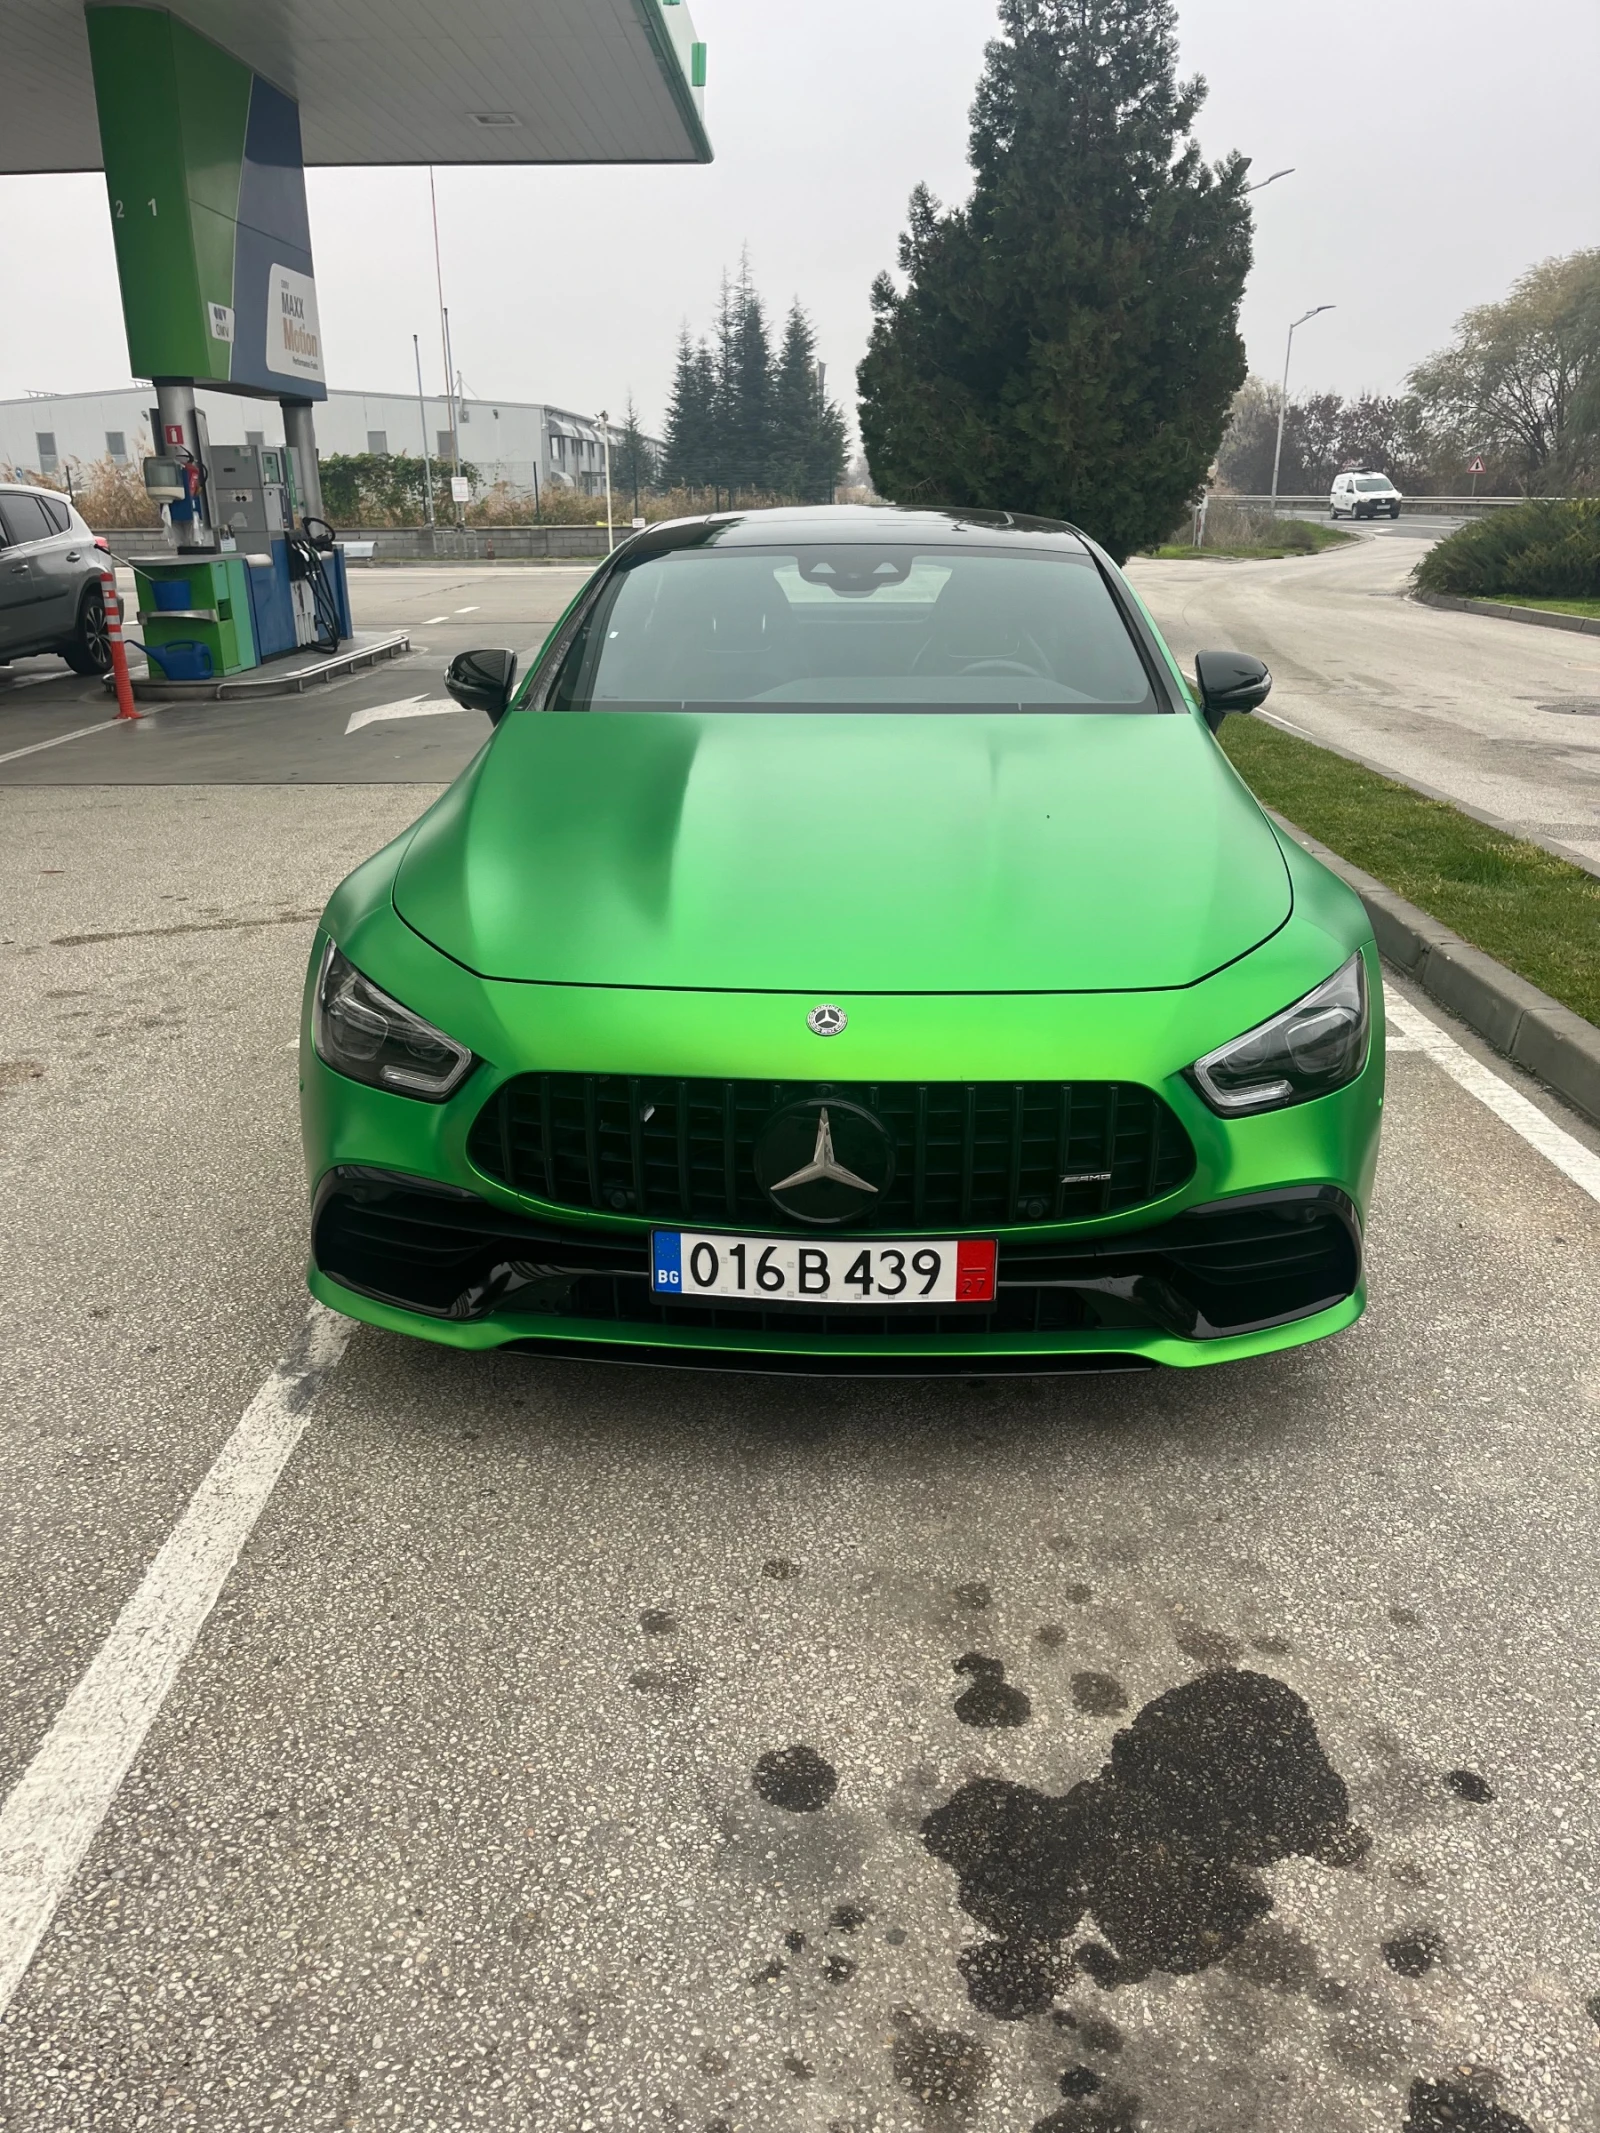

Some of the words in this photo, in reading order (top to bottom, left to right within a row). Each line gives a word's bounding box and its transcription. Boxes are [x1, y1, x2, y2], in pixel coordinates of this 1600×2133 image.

[115, 199, 125, 218] 2
[147, 198, 157, 216] 1
[281, 291, 304, 319] MAXX
[283, 317, 318, 357] Motion
[1077, 1173, 1112, 1182] AMG
[658, 1269, 679, 1284] BG
